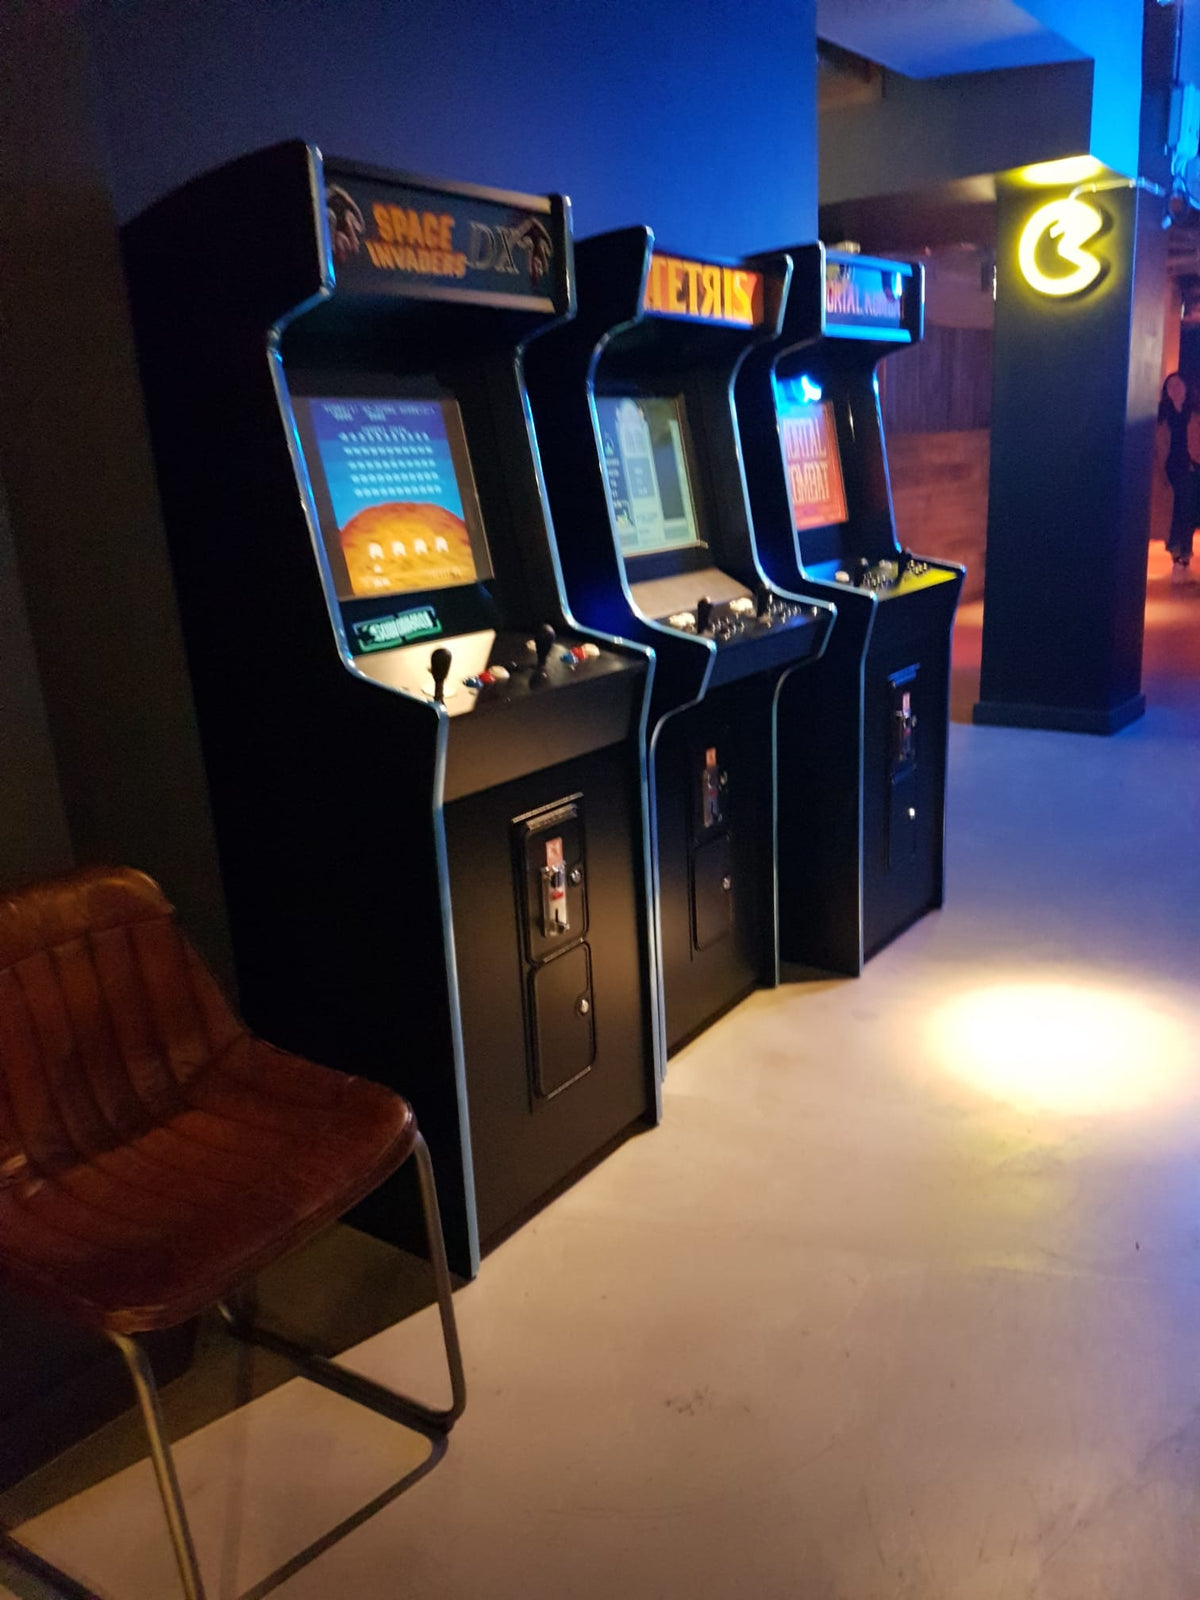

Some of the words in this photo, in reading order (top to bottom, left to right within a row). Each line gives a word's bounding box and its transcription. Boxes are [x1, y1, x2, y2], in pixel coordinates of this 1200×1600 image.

[372, 203, 455, 250] SPACE
[469, 220, 525, 275] DX
[365, 240, 467, 280] INVADERS
[826, 280, 863, 315] ORTAL
